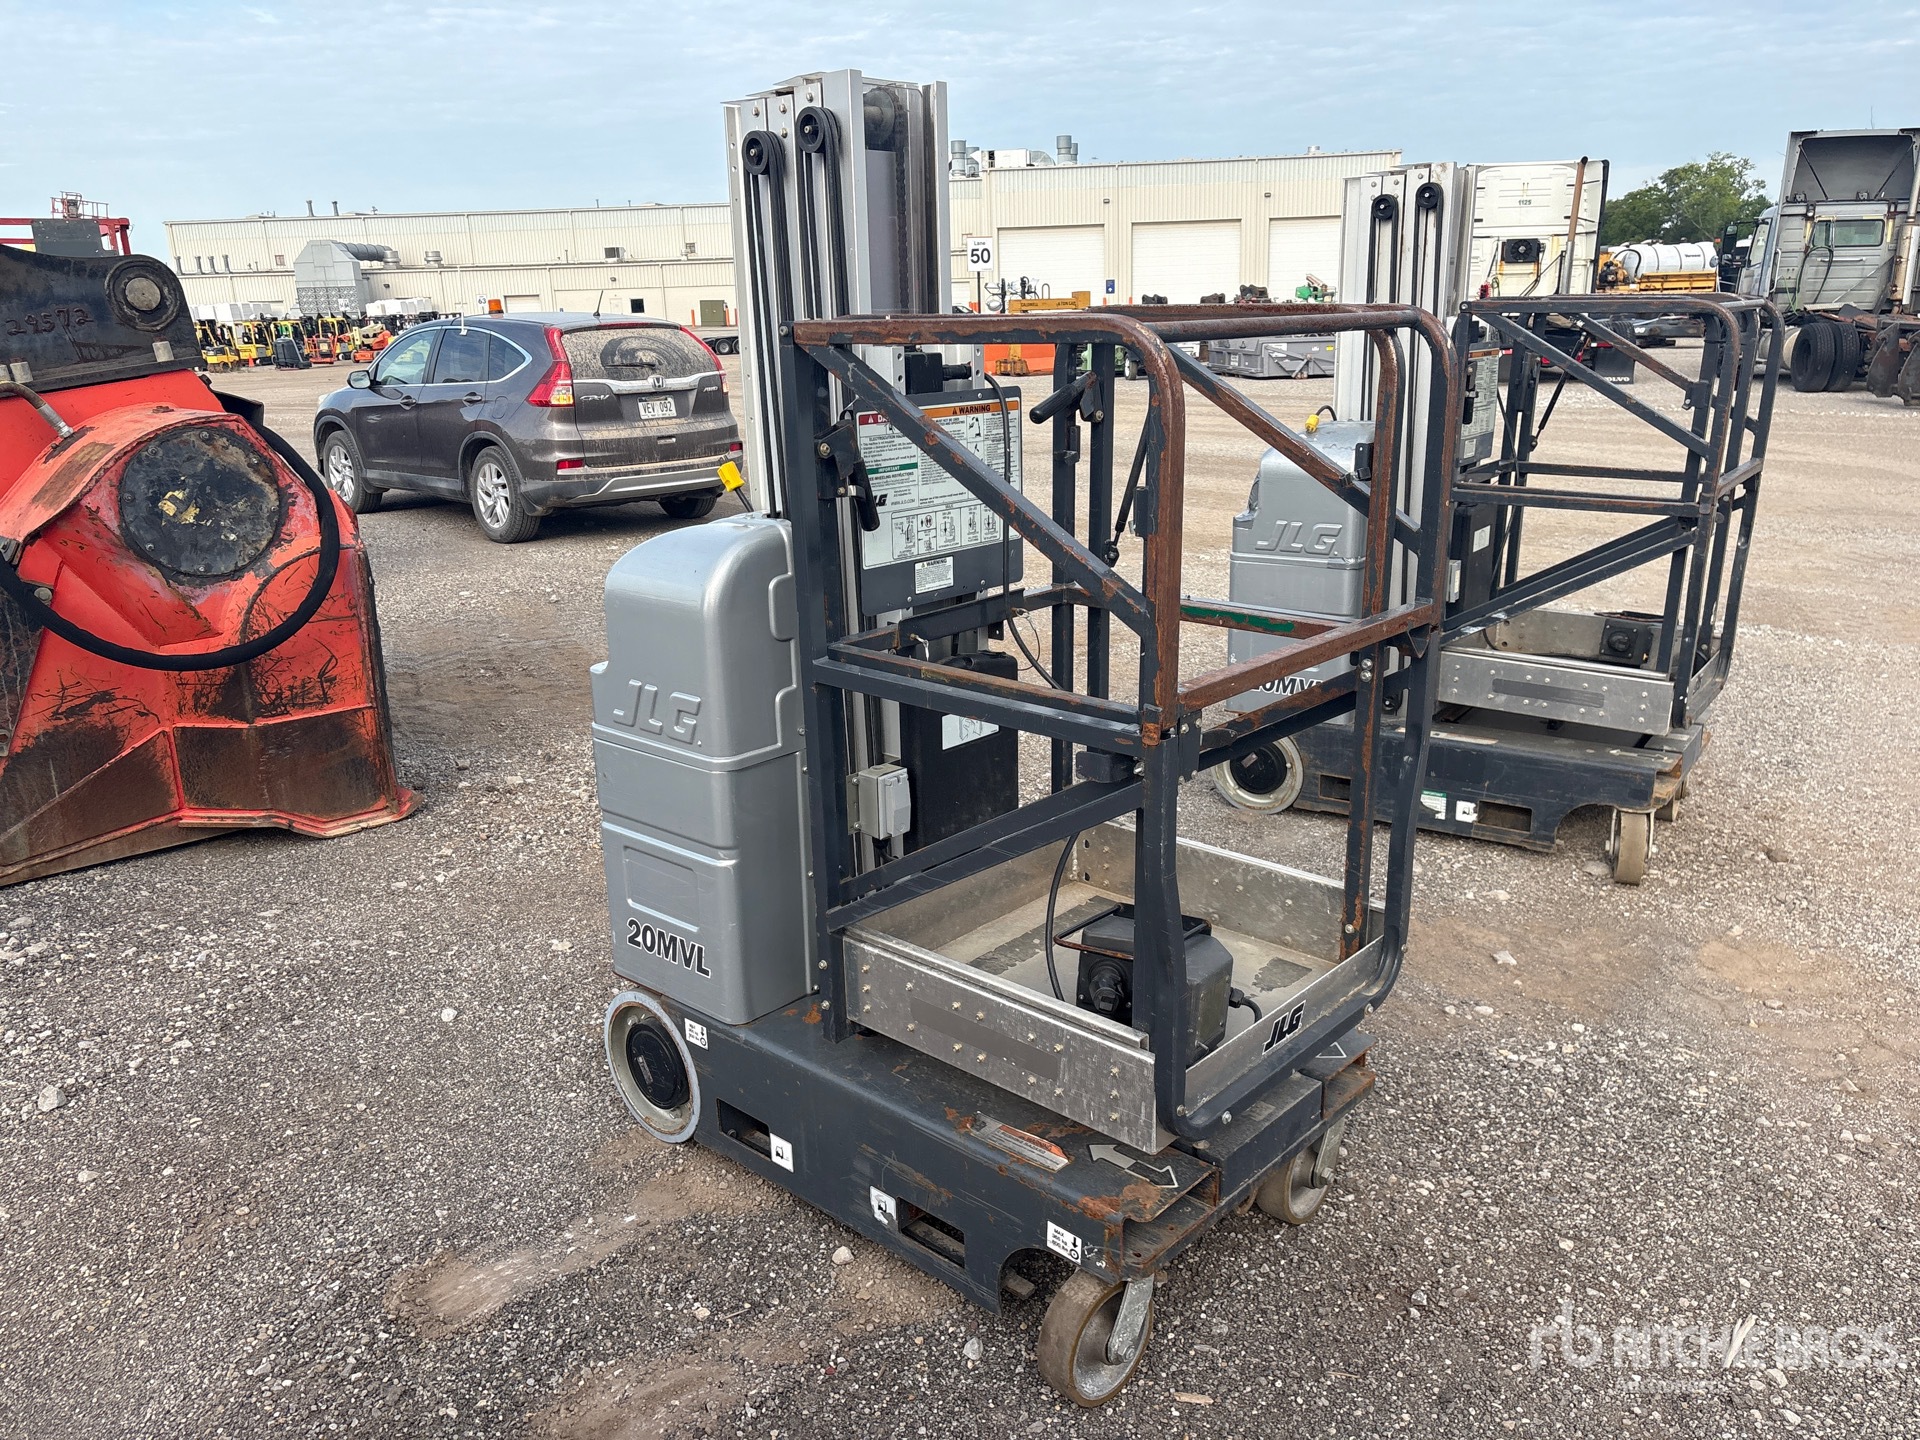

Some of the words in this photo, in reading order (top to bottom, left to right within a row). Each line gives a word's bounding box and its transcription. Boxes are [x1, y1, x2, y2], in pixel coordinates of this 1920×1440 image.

[970, 247, 991, 264] 50
[5, 308, 94, 336] 29572
[660, 401, 673, 412] 092
[959, 404, 991, 415] WARNING
[878, 465, 900, 473] IMPORTANT
[1255, 519, 1343, 556] JLG
[1249, 676, 1324, 696] 0MV
[611, 678, 702, 746] JLG
[626, 918, 712, 977] 20MVL
[1262, 1000, 1307, 1055] JLG
